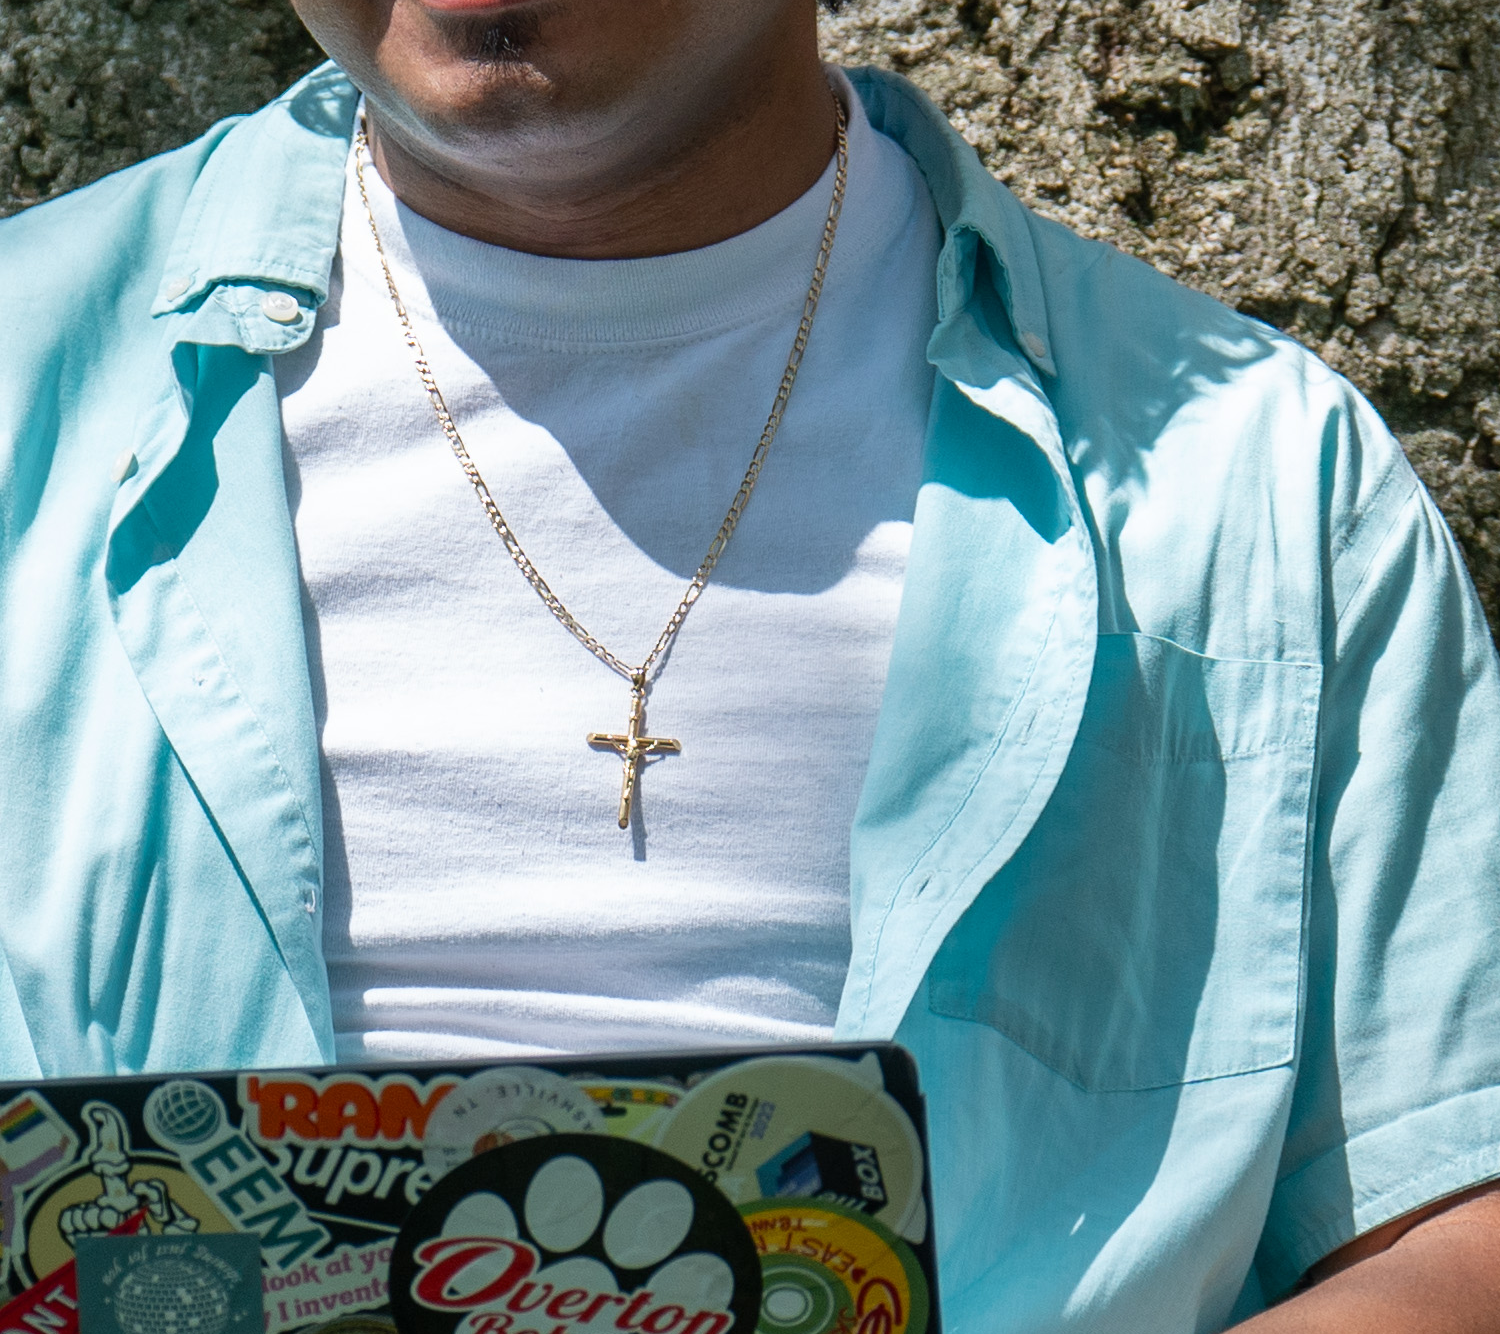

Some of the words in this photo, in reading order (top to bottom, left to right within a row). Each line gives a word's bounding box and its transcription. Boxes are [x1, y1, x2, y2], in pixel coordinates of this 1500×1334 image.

[851, 1143, 884, 1201] BOX
[262, 1262, 321, 1294] look
[326, 1251, 352, 1276] at
[779, 1232, 856, 1273] EAST
[278, 1301, 289, 1323] I
